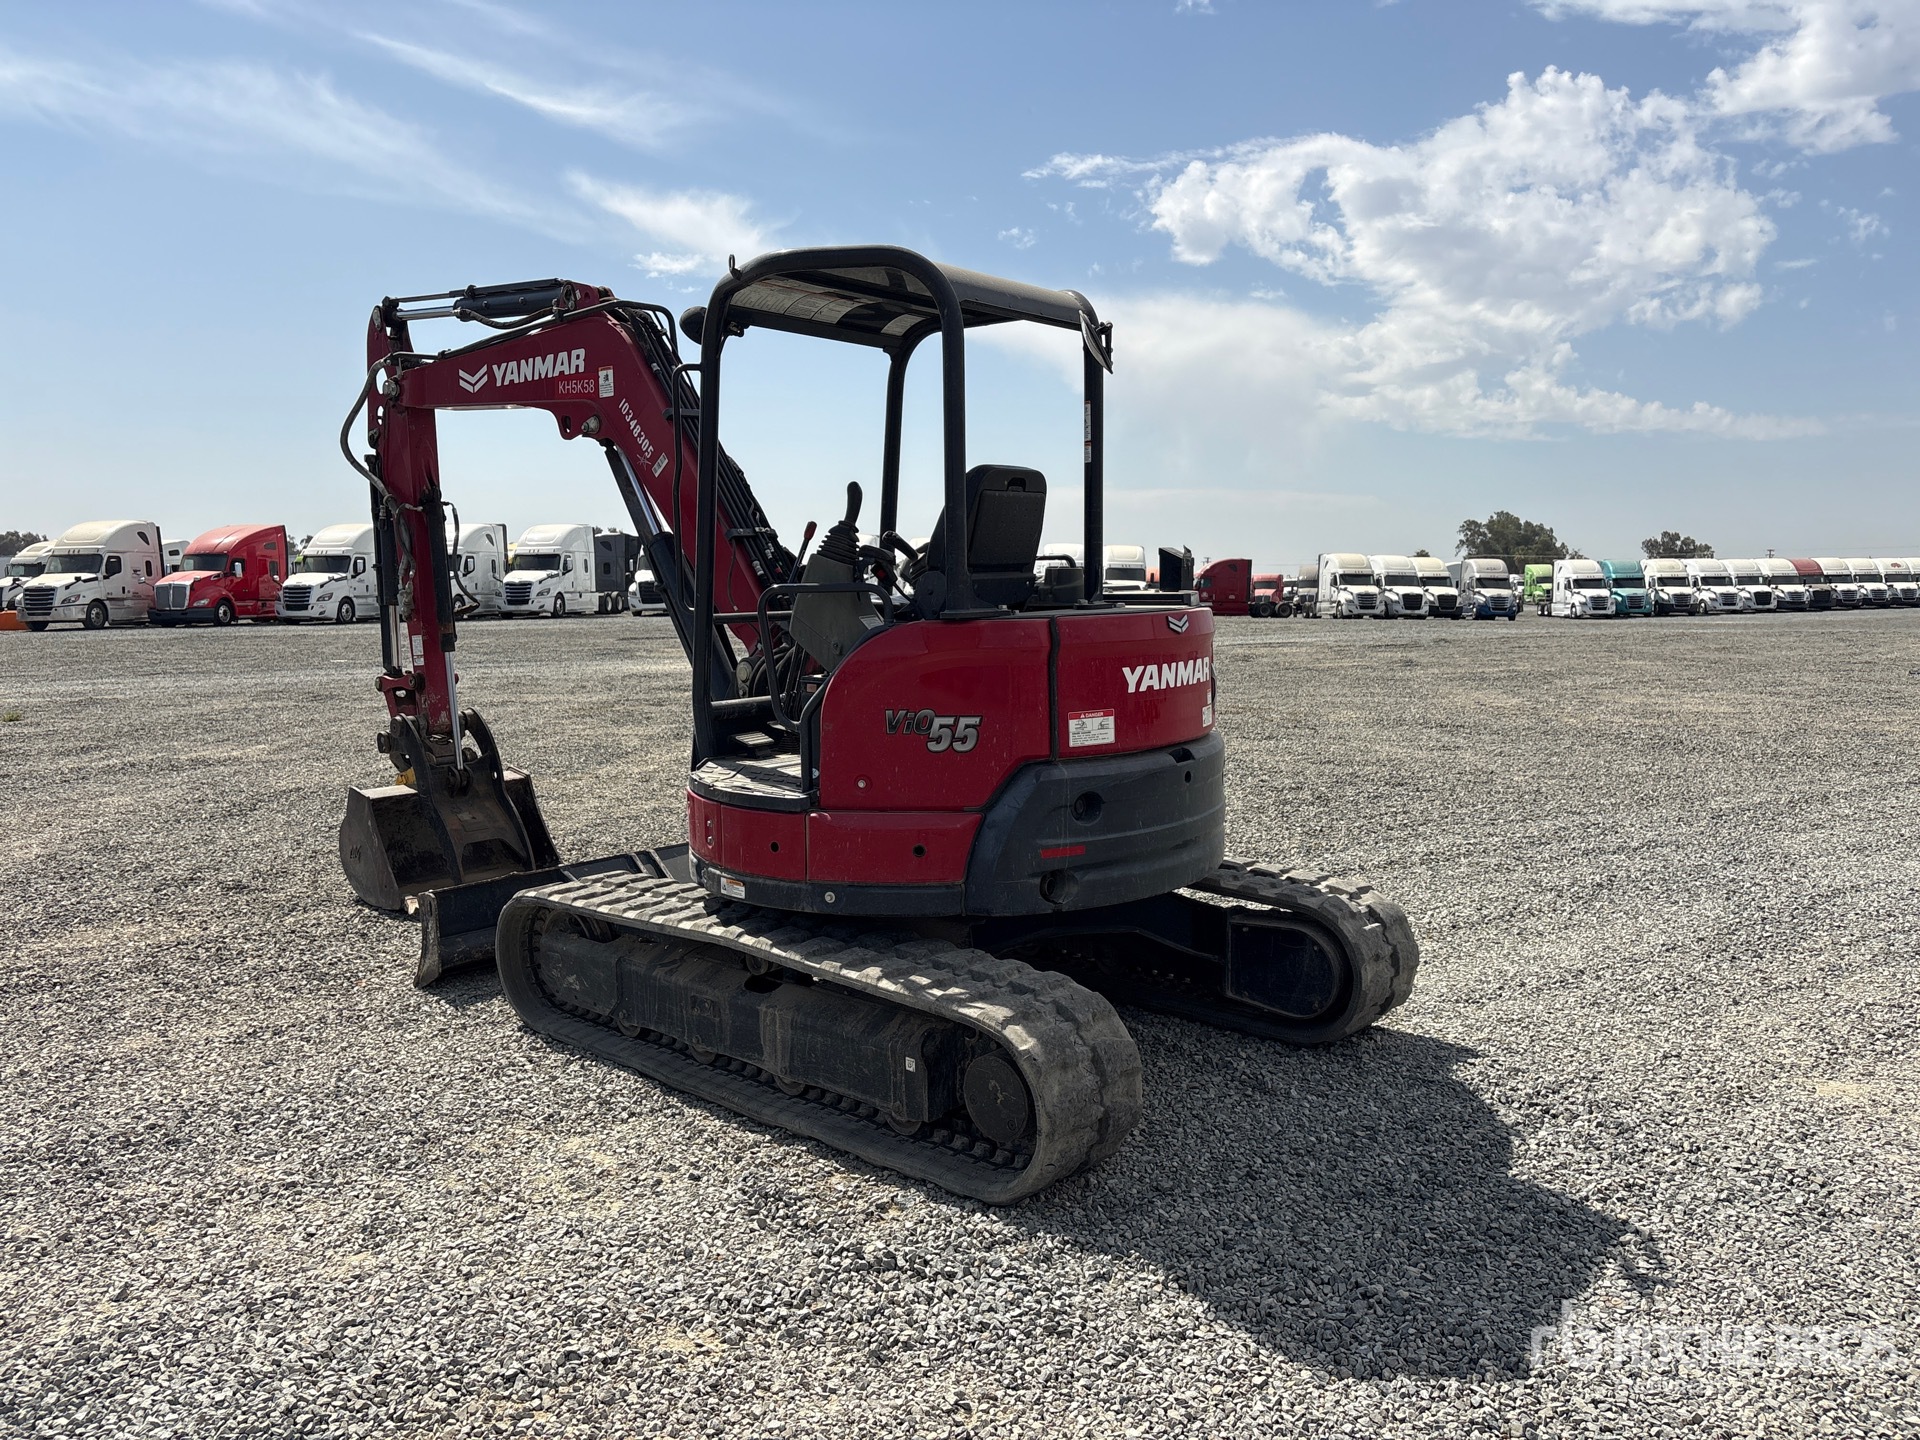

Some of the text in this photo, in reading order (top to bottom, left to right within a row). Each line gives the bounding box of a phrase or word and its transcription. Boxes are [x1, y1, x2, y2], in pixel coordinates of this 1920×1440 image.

[492, 348, 586, 387] YANMAR
[558, 379, 595, 394] KH5K58
[618, 398, 654, 459] 10348305
[1122, 656, 1210, 694] YANMAR
